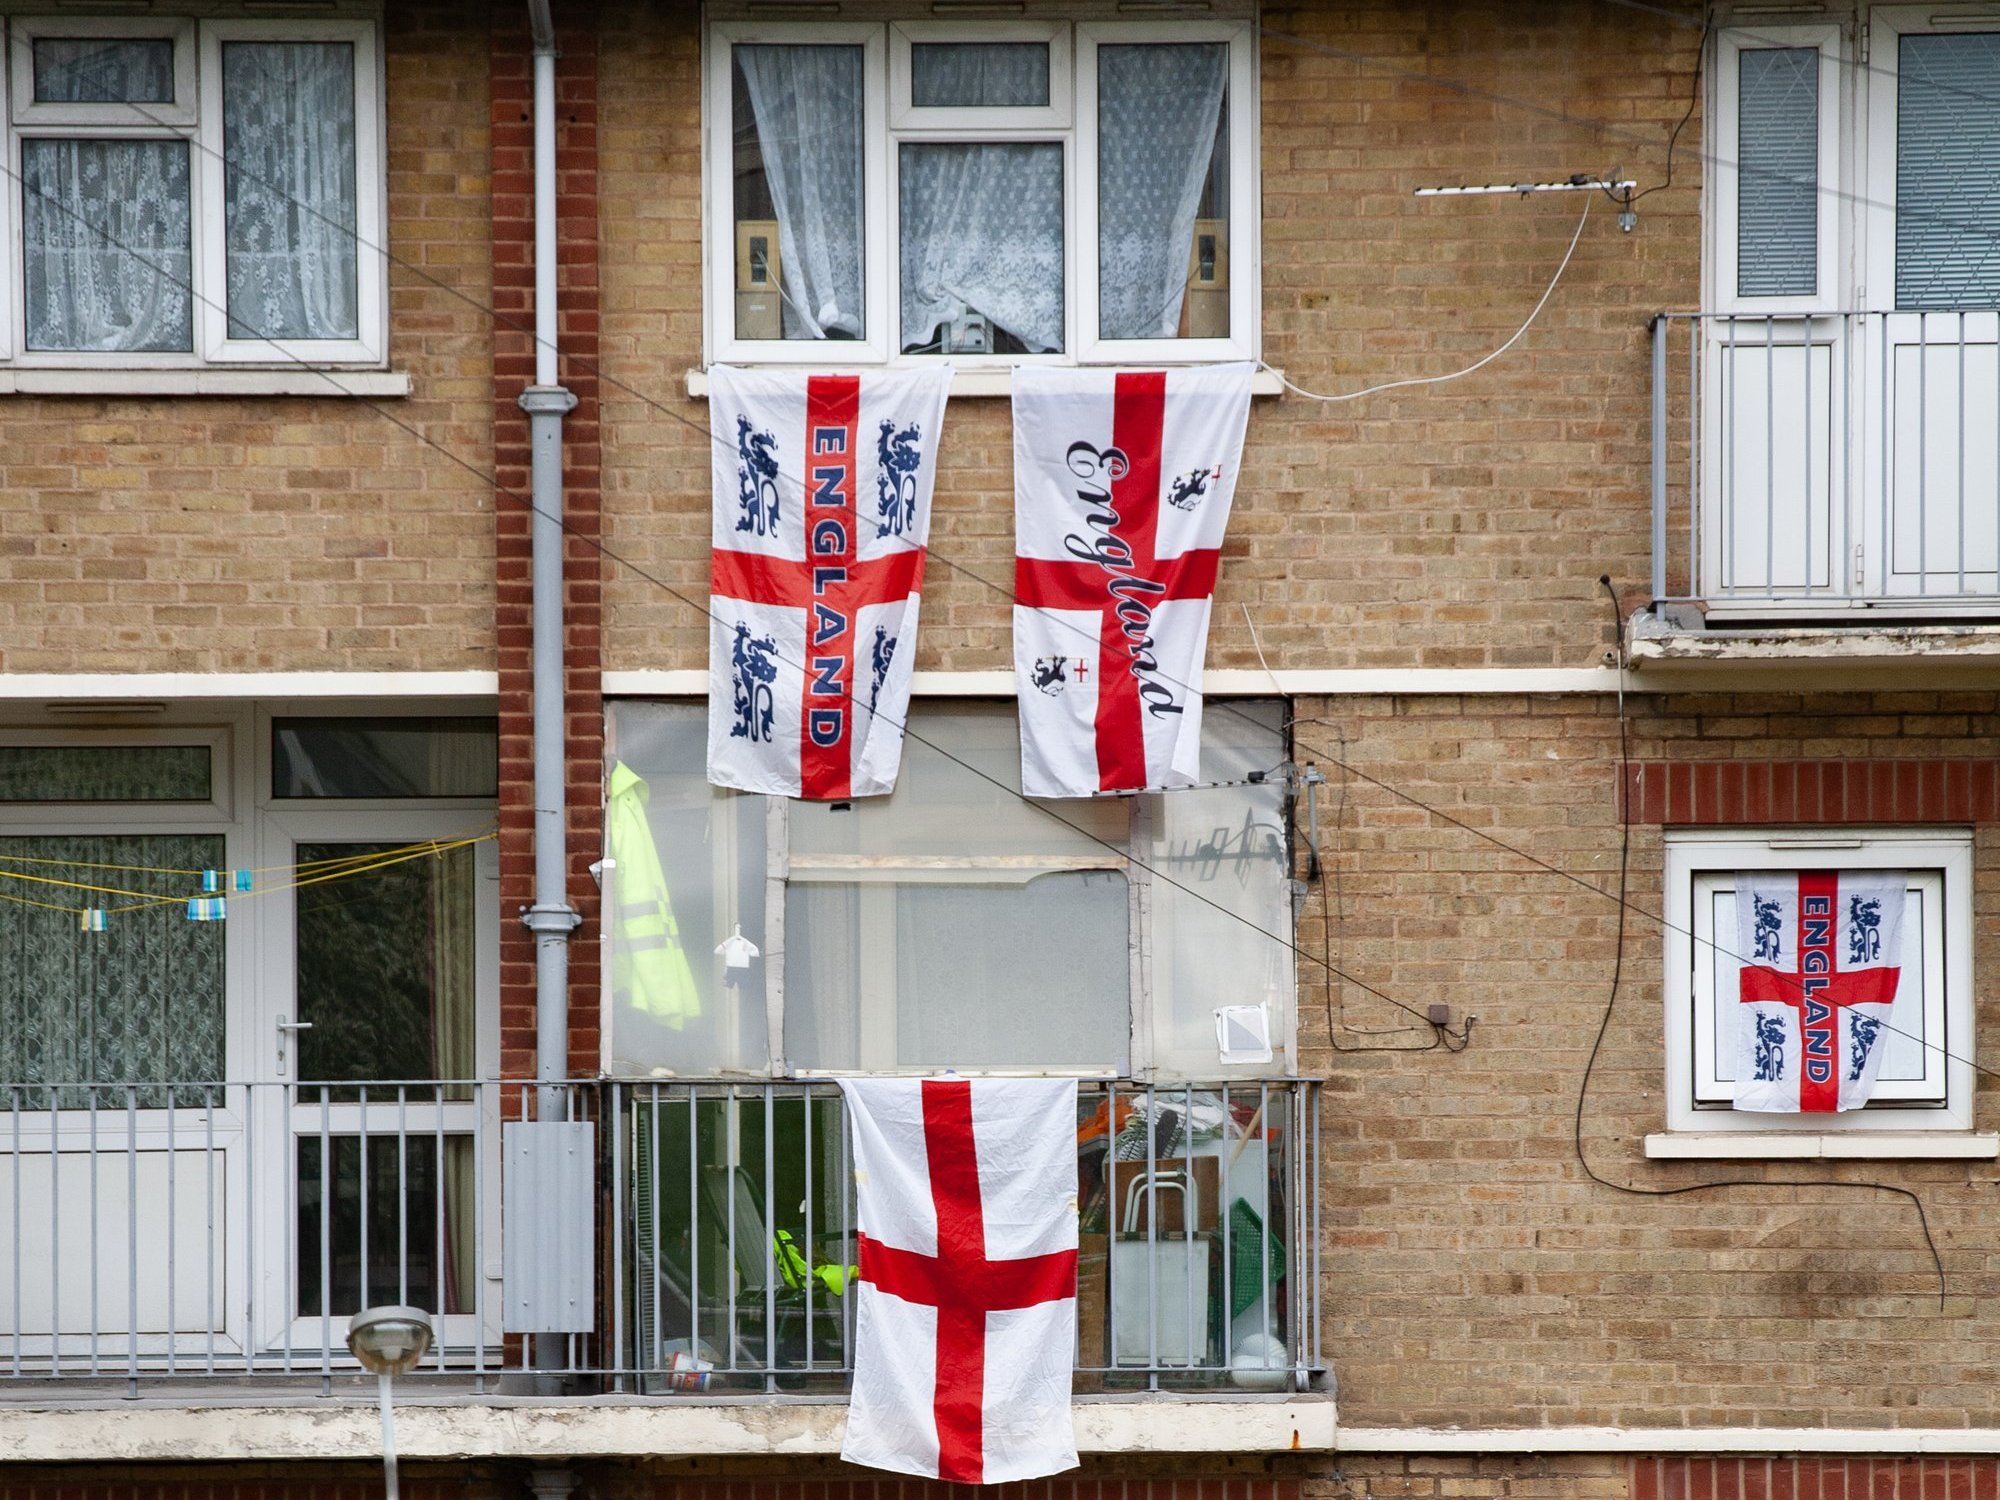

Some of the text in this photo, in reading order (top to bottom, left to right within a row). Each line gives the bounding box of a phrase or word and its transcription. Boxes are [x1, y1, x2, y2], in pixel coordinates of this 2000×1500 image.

[811, 426, 847, 747] ENGLAND
[1065, 440, 1184, 720] England
[1804, 896, 1831, 1083] ENGLAND
